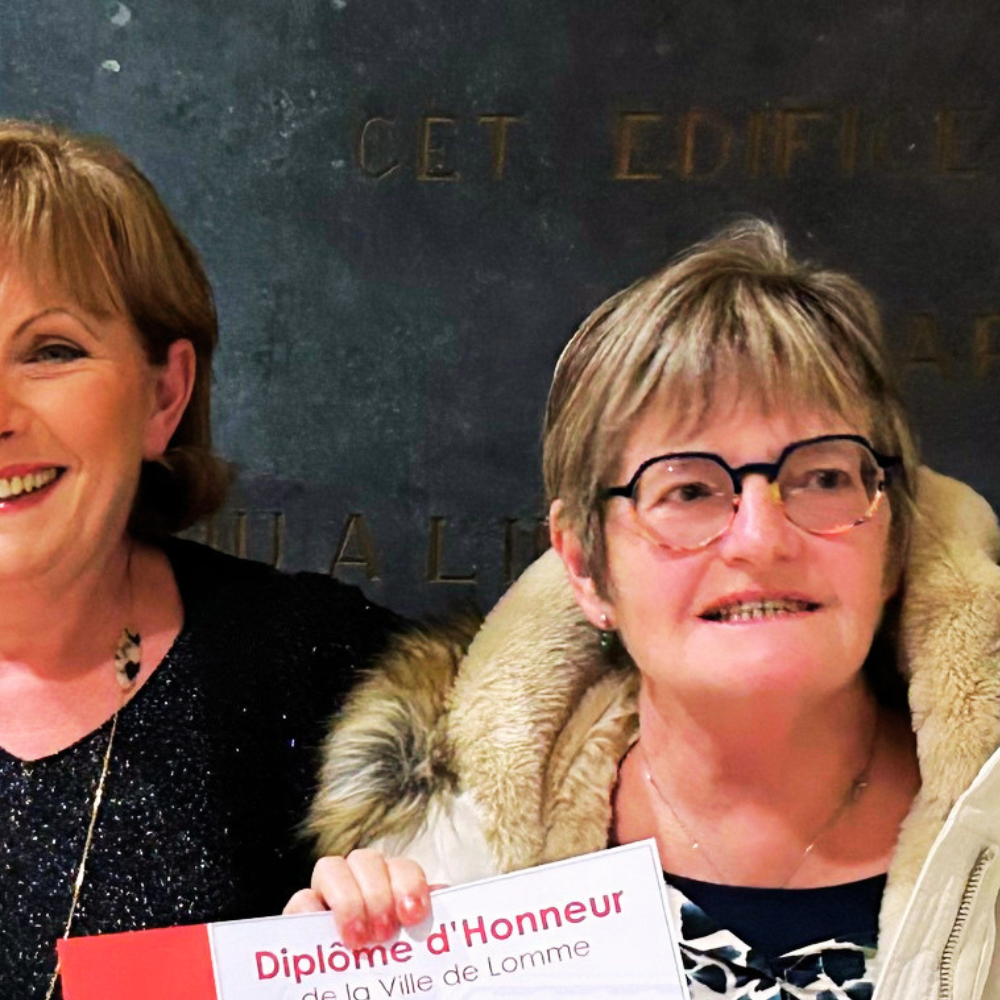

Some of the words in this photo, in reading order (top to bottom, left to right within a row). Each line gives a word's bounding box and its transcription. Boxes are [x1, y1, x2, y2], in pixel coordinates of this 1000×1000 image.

[356, 113, 525, 182] CET
[612, 107, 982, 181] EDIFICE
[255, 938, 412, 983] Diplôme
[426, 890, 623, 955] d'Honneur
[379, 973, 432, 997] Ville
[443, 960, 478, 986] de
[488, 939, 590, 976] Lomme
